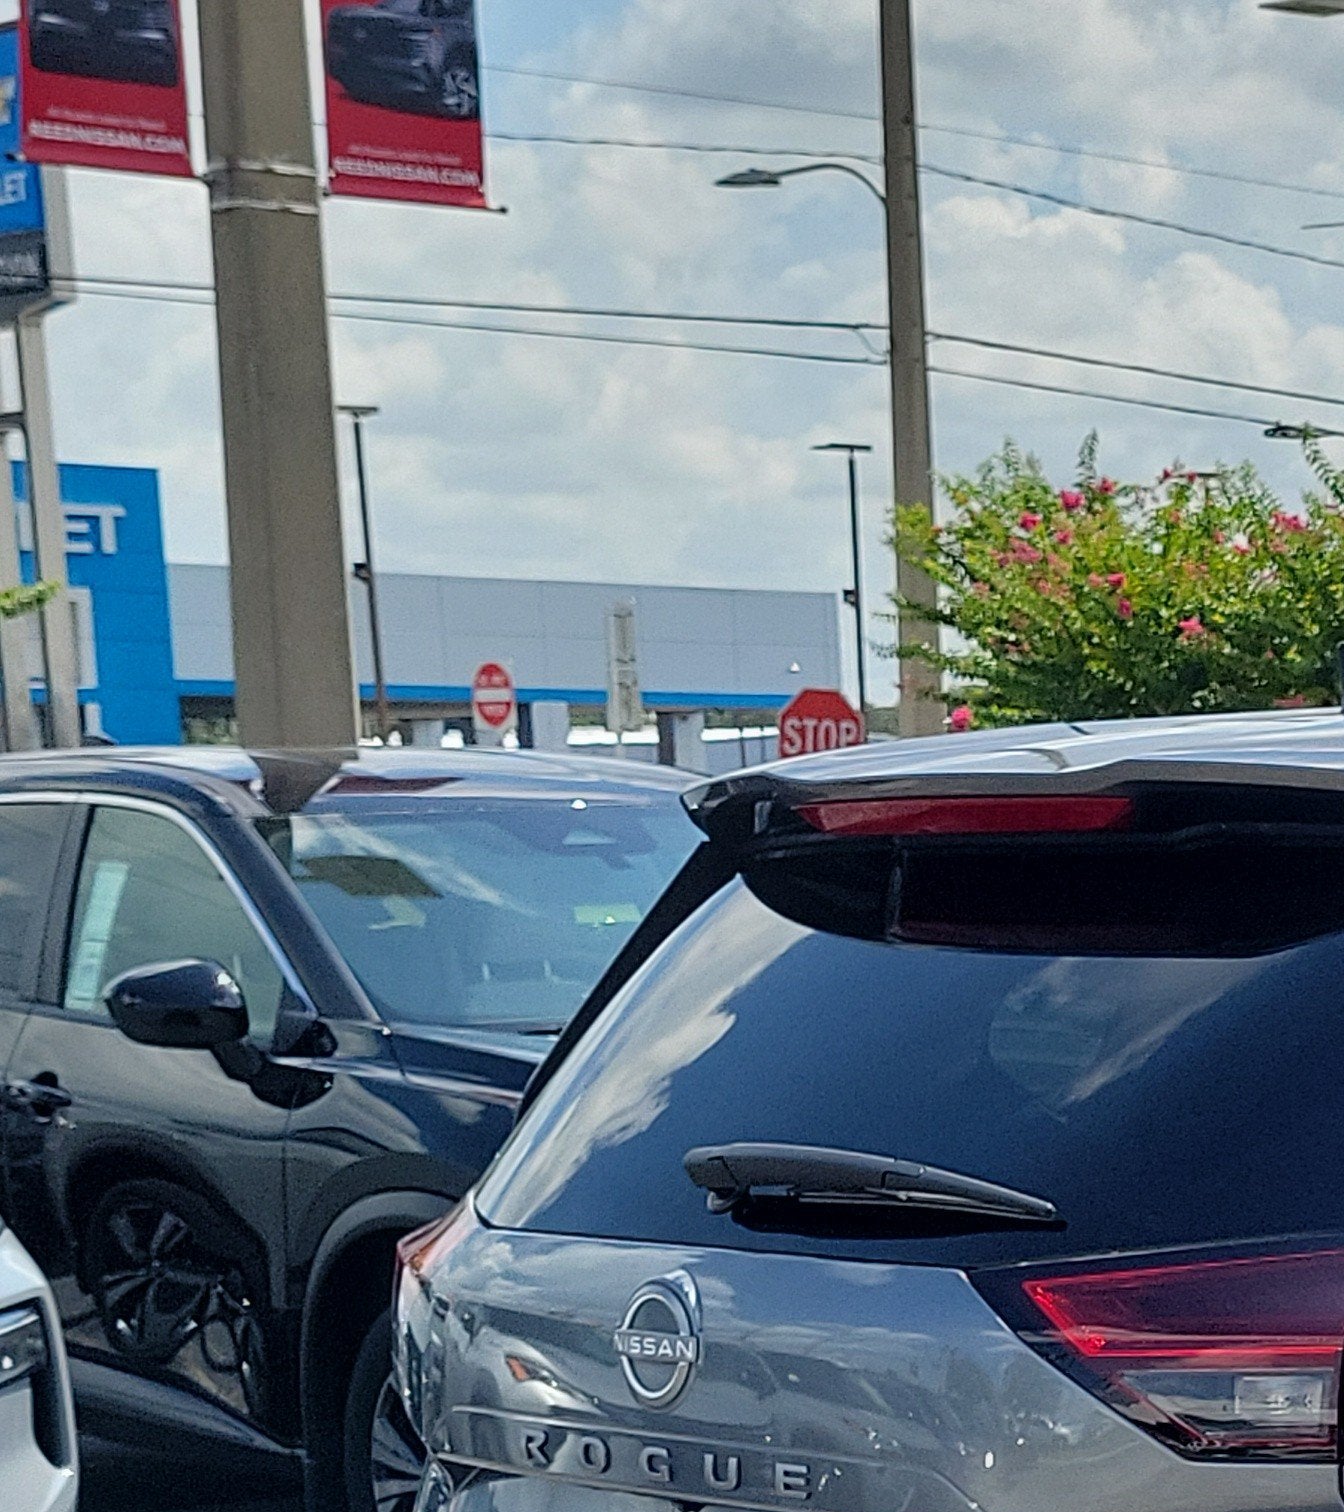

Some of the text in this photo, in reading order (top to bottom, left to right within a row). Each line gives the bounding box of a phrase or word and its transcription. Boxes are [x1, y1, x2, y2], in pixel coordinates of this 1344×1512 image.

[783, 716, 858, 753] STOP
[614, 1334, 693, 1359] NISSAN
[521, 1427, 811, 1500] ROGUE
